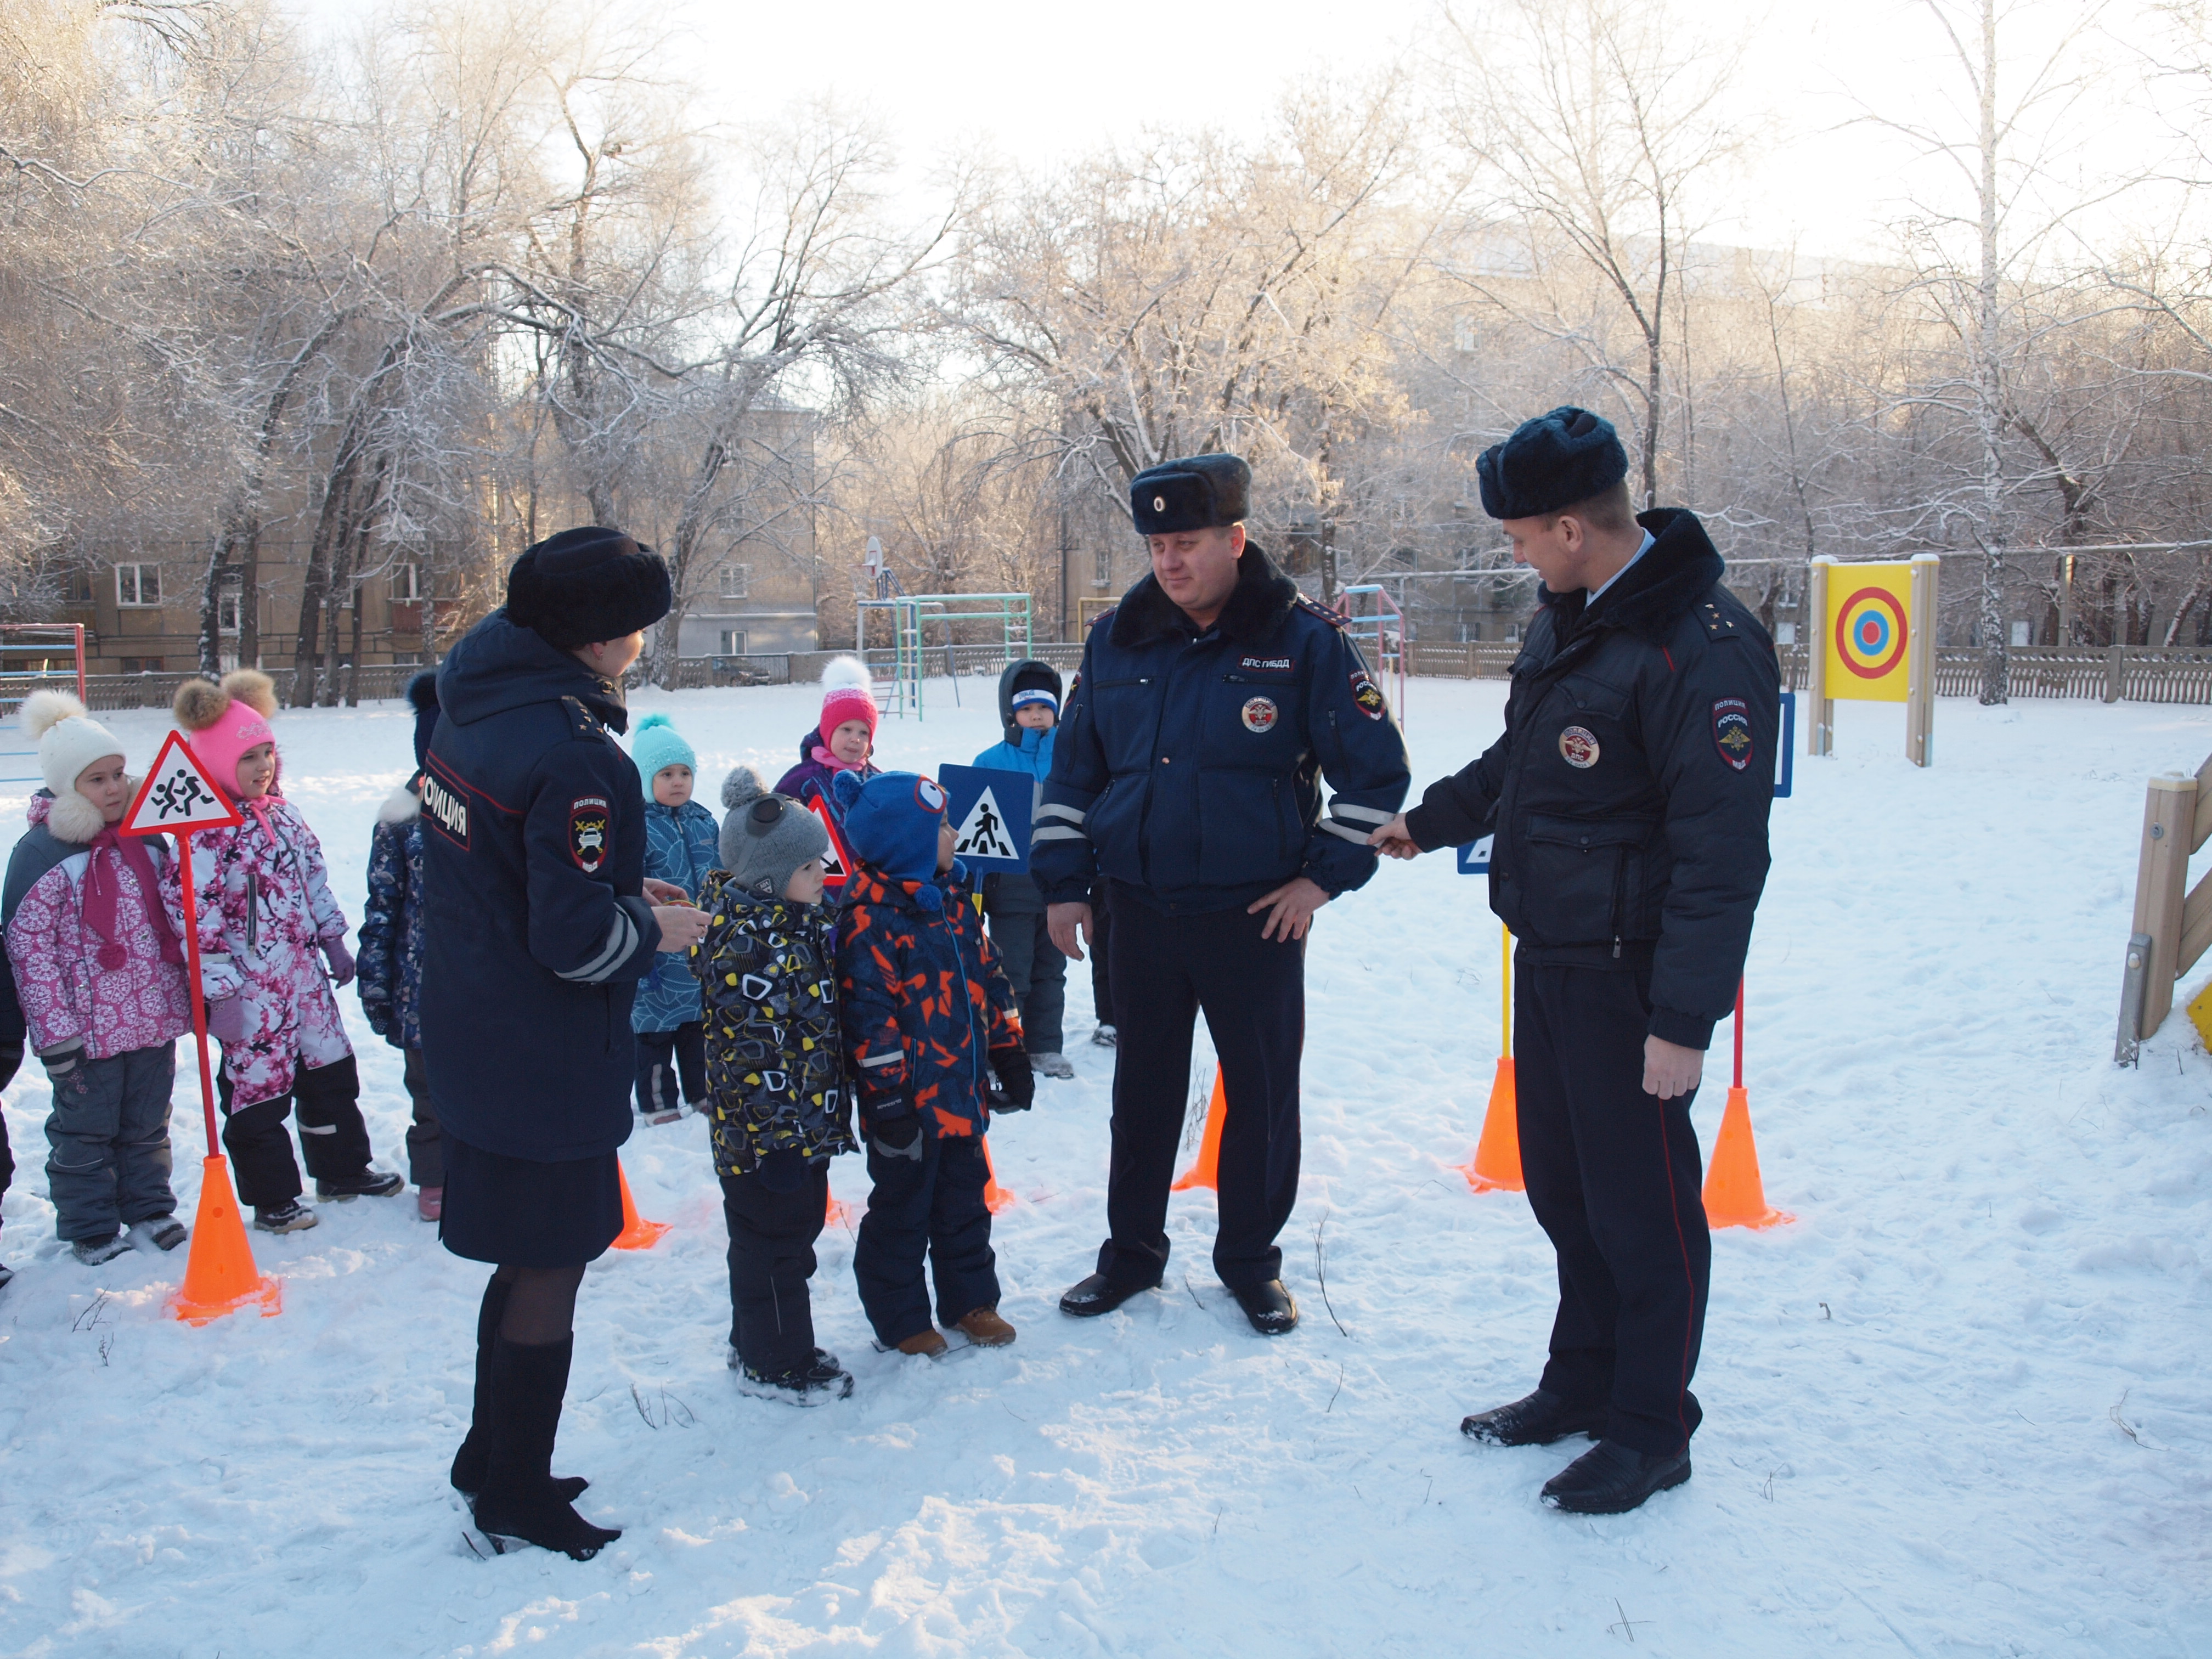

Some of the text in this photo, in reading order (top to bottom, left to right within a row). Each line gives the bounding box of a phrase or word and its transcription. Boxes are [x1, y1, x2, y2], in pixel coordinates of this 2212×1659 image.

[1242, 657, 1290, 668] ДПС ГИБДД
[1714, 699, 1746, 712] ПОЛИЦИЯ
[1718, 714, 1748, 728] РОССИЯ
[1565, 728, 1595, 744] ПОЛИЦИЯ
[1571, 752, 1584, 761] ДПС
[573, 798, 607, 810] ПОЛИЦИЯ
